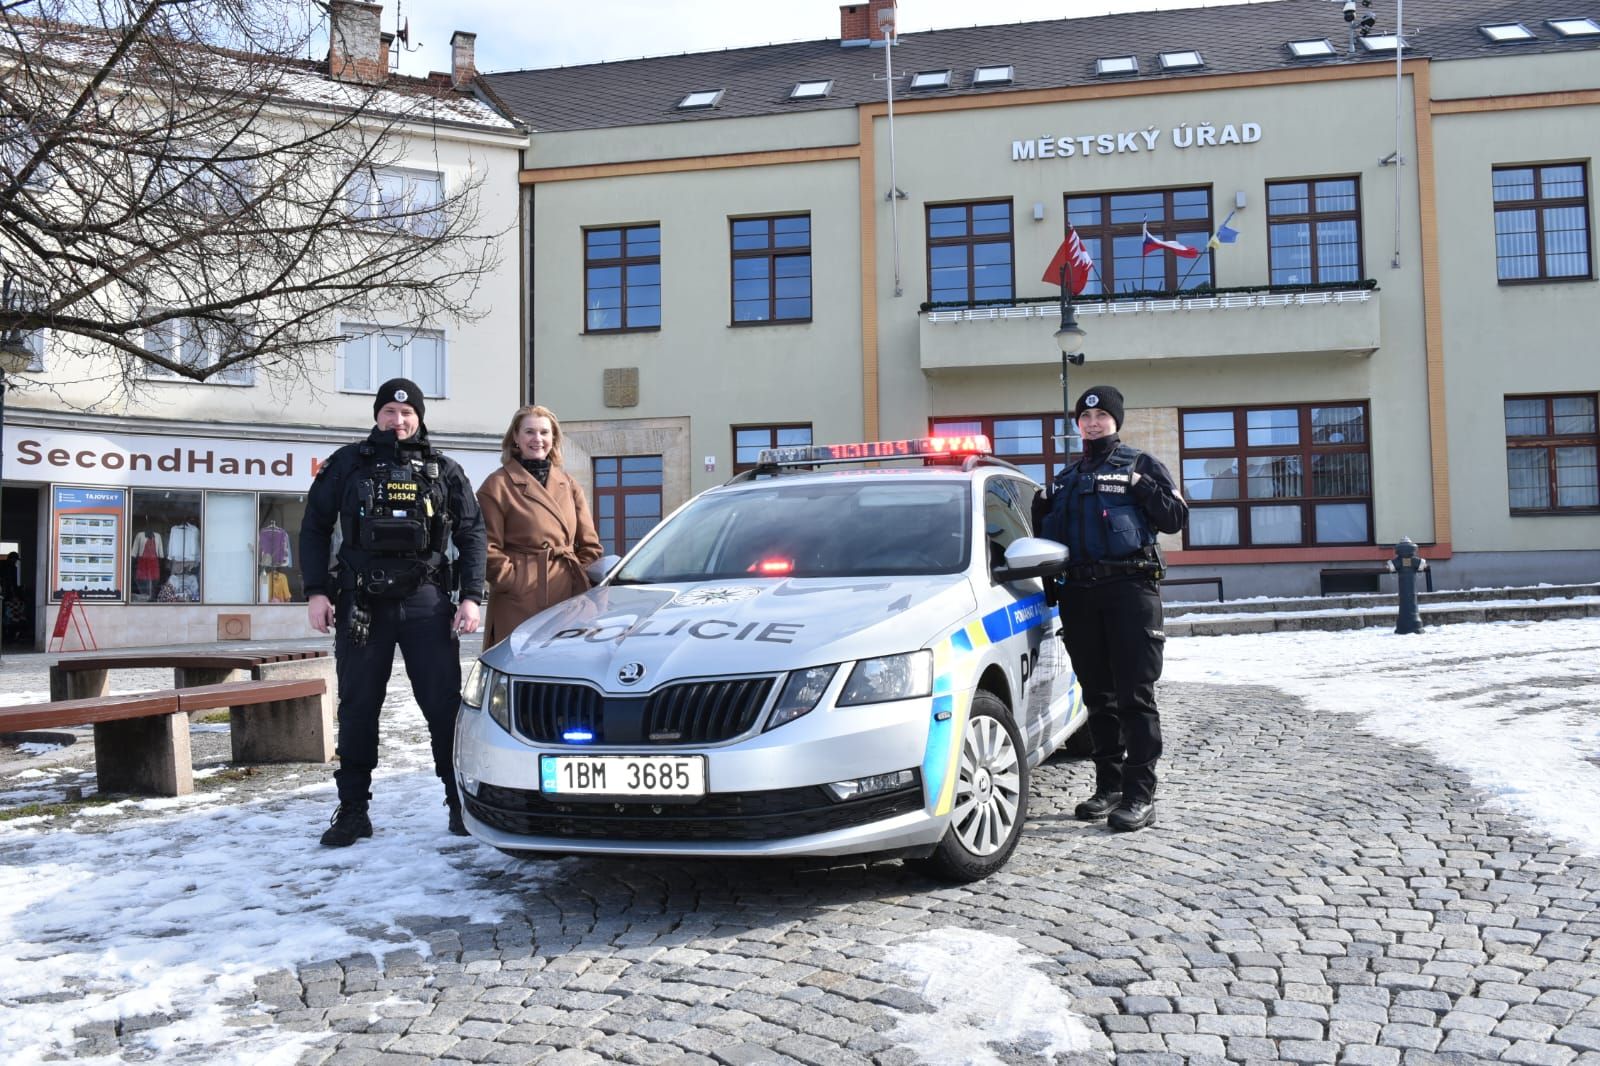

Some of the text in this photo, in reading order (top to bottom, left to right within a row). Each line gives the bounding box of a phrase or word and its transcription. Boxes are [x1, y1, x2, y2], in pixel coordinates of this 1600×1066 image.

[1012, 122, 1262, 160] MĚSTSKÝ ÚŘAD
[16, 440, 293, 476] SecondHand
[540, 619, 804, 648] POLICIE
[564, 762, 689, 789] 1BM 3685
